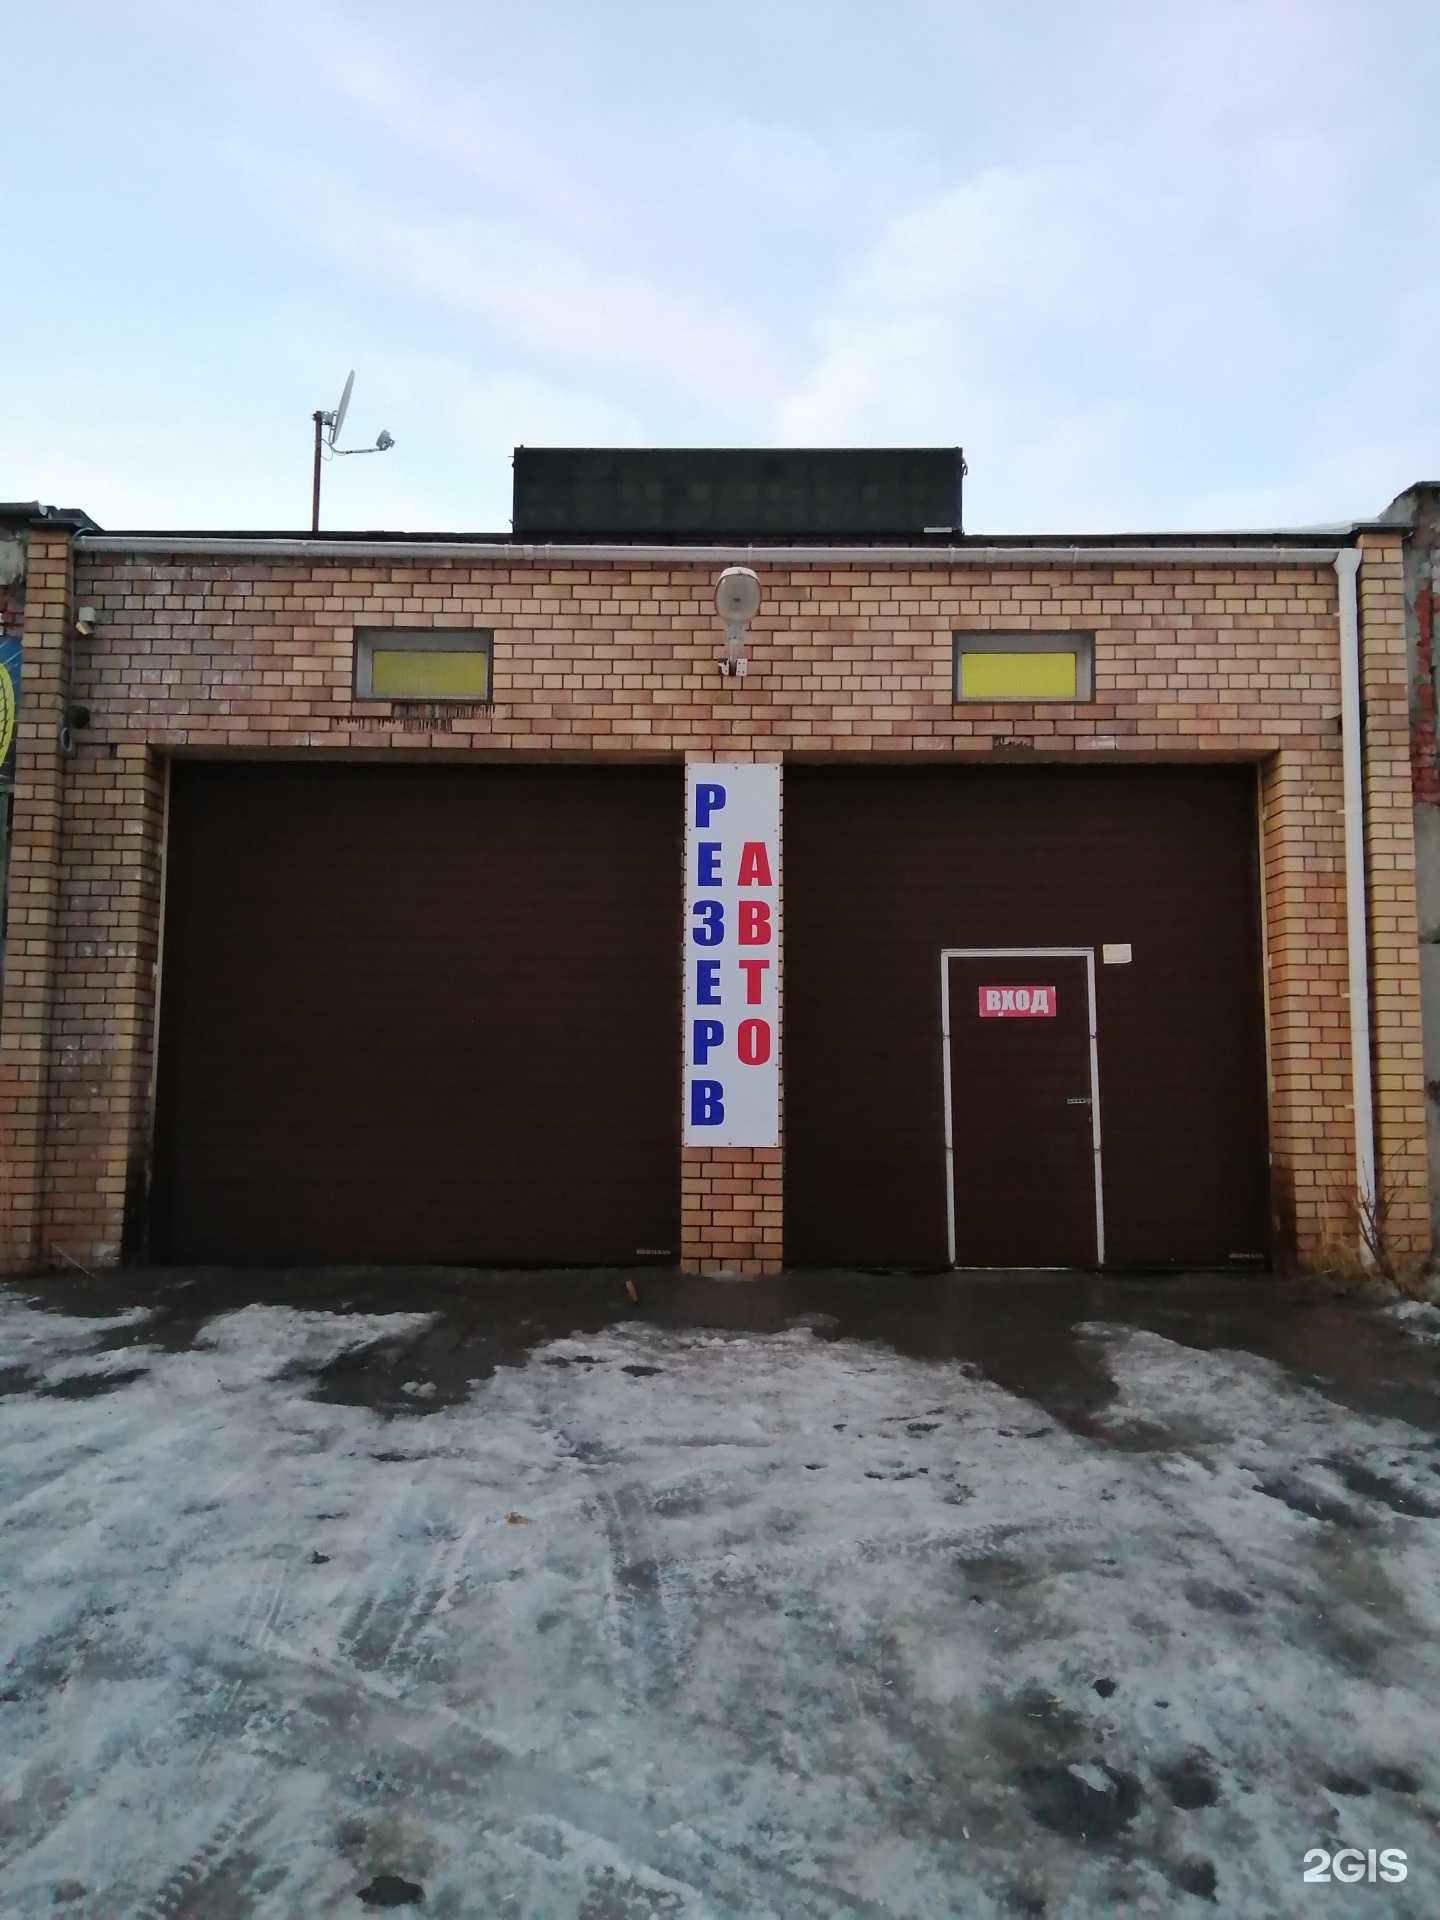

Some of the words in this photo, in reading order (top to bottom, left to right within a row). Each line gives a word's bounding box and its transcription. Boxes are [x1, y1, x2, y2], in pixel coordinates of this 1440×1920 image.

[691, 784, 726, 1126] РЕЗЕРВ
[737, 842, 773, 1066] АВТО
[986, 990, 1049, 1014] ВХОД
